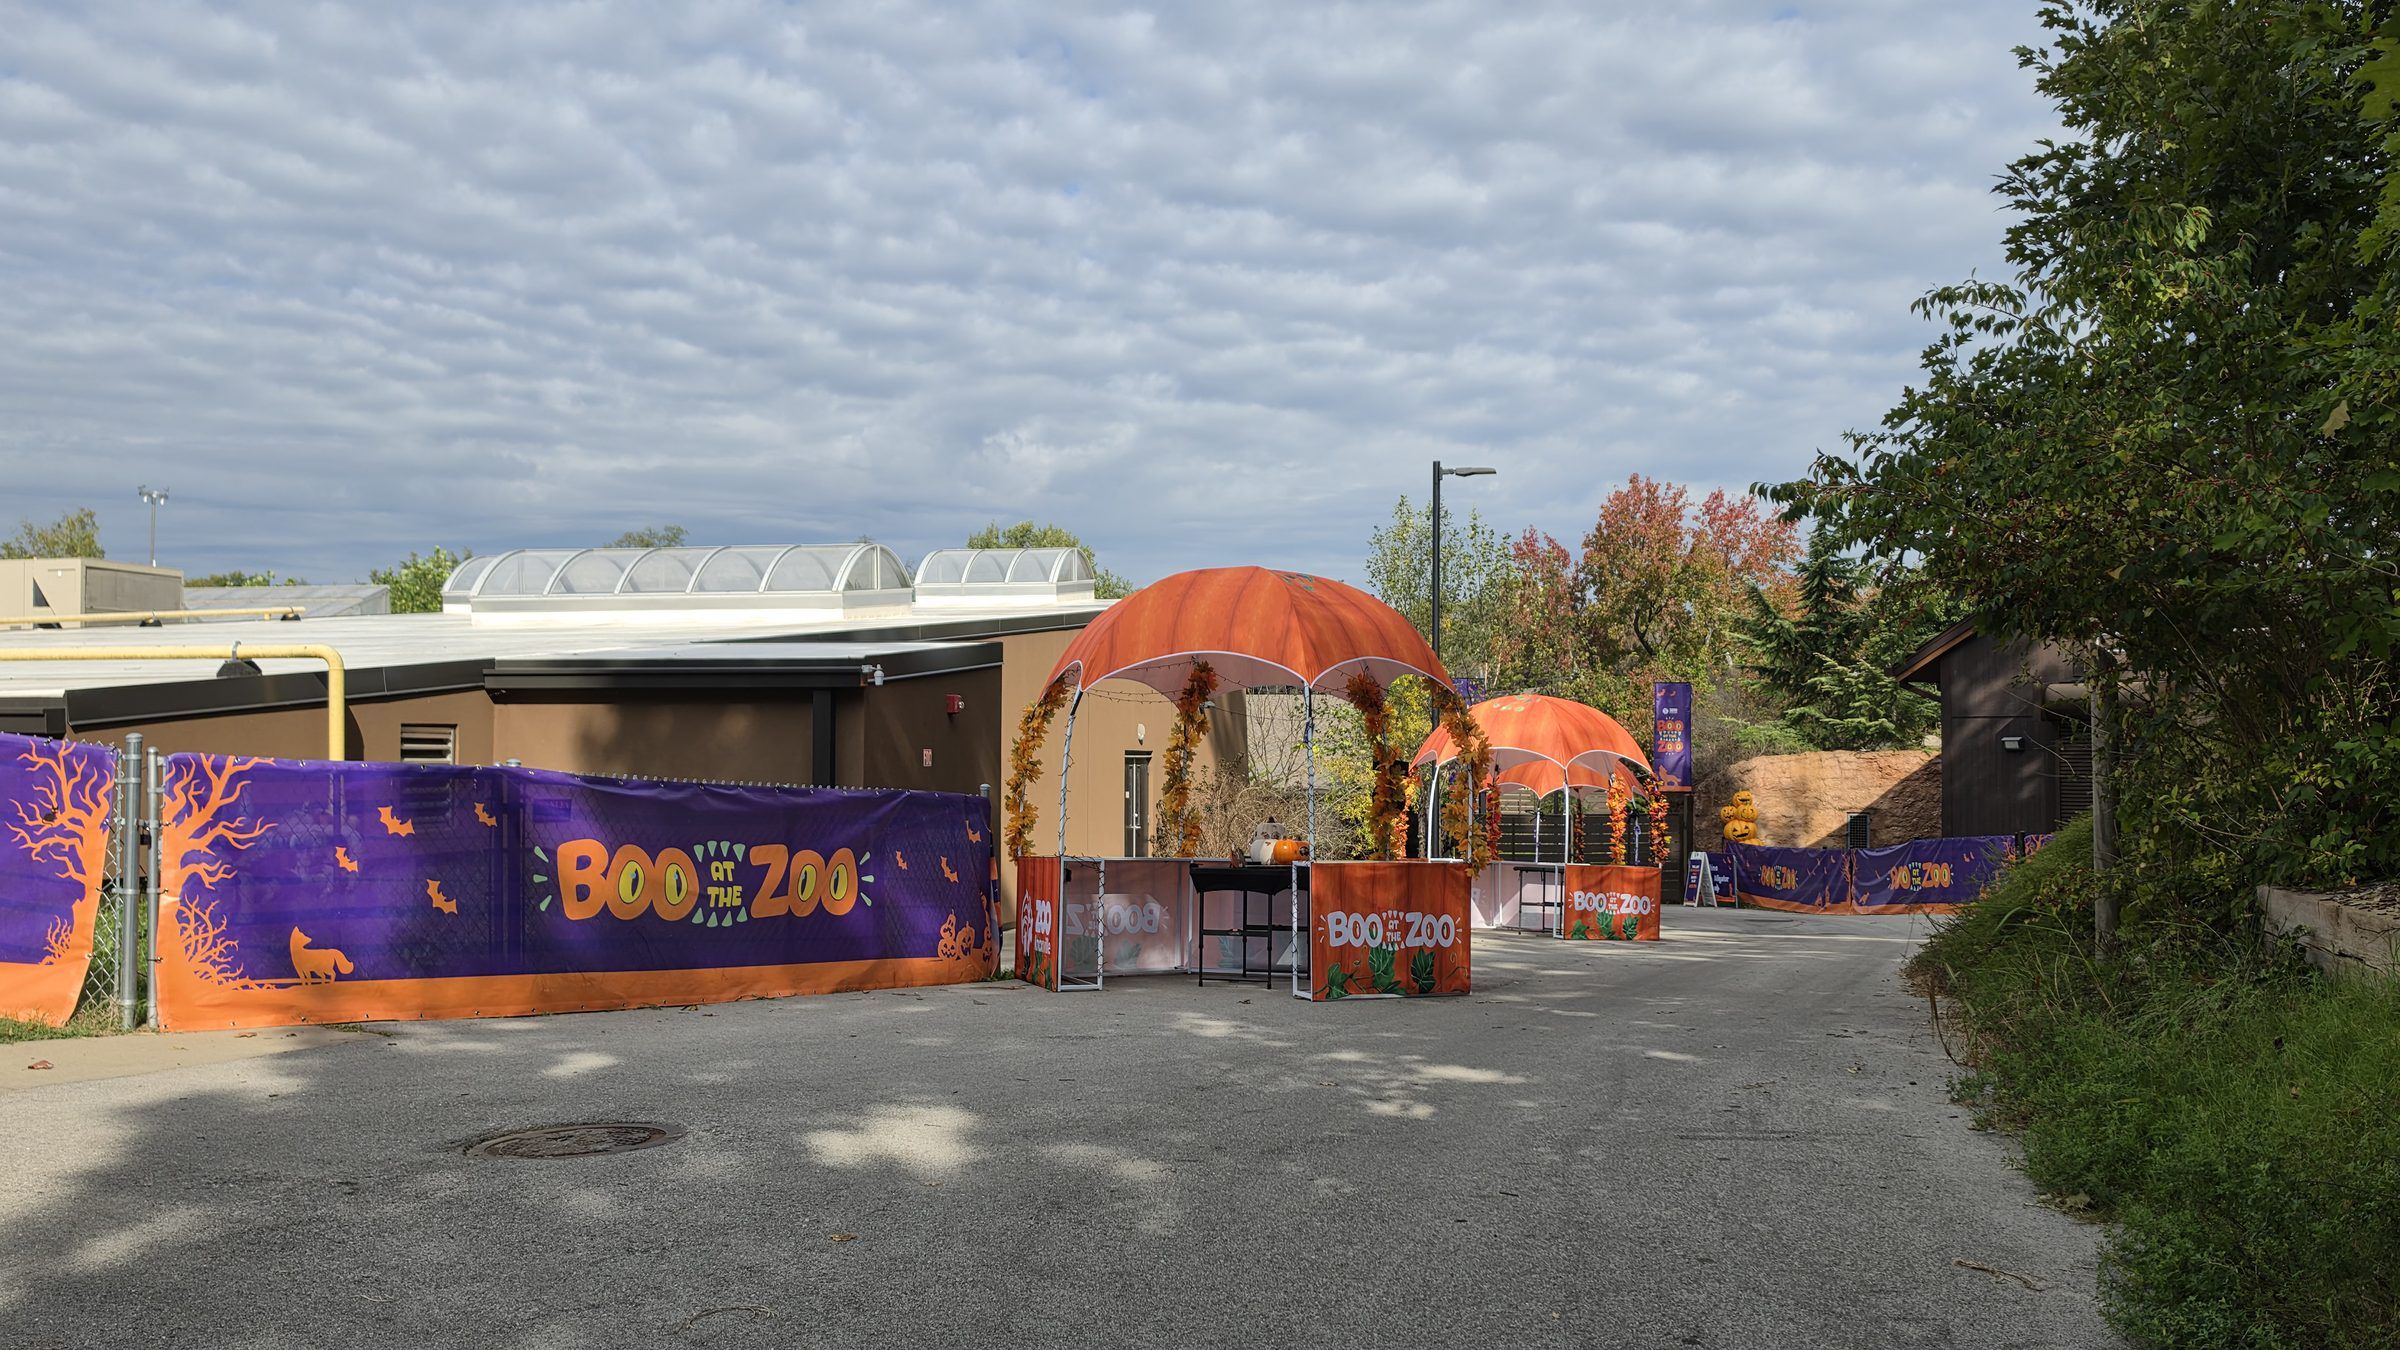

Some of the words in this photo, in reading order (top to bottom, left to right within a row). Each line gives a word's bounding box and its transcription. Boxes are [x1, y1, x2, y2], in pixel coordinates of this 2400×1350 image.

[1657, 719, 1684, 732] BOO
[1657, 740, 1684, 753] ZOO
[557, 838, 699, 921] BOO
[711, 861, 735, 882] AT
[750, 843, 858, 918] ZOO
[1922, 862, 1951, 888] ZOO
[707, 885, 743, 908] THE
[1573, 890, 1607, 913] BOO
[1620, 893, 1651, 915] ZOO
[1327, 911, 1383, 948] BOO
[1386, 931, 1402, 942] THE
[1388, 920, 1399, 930] AT
[1405, 911, 1456, 948] ZOO
